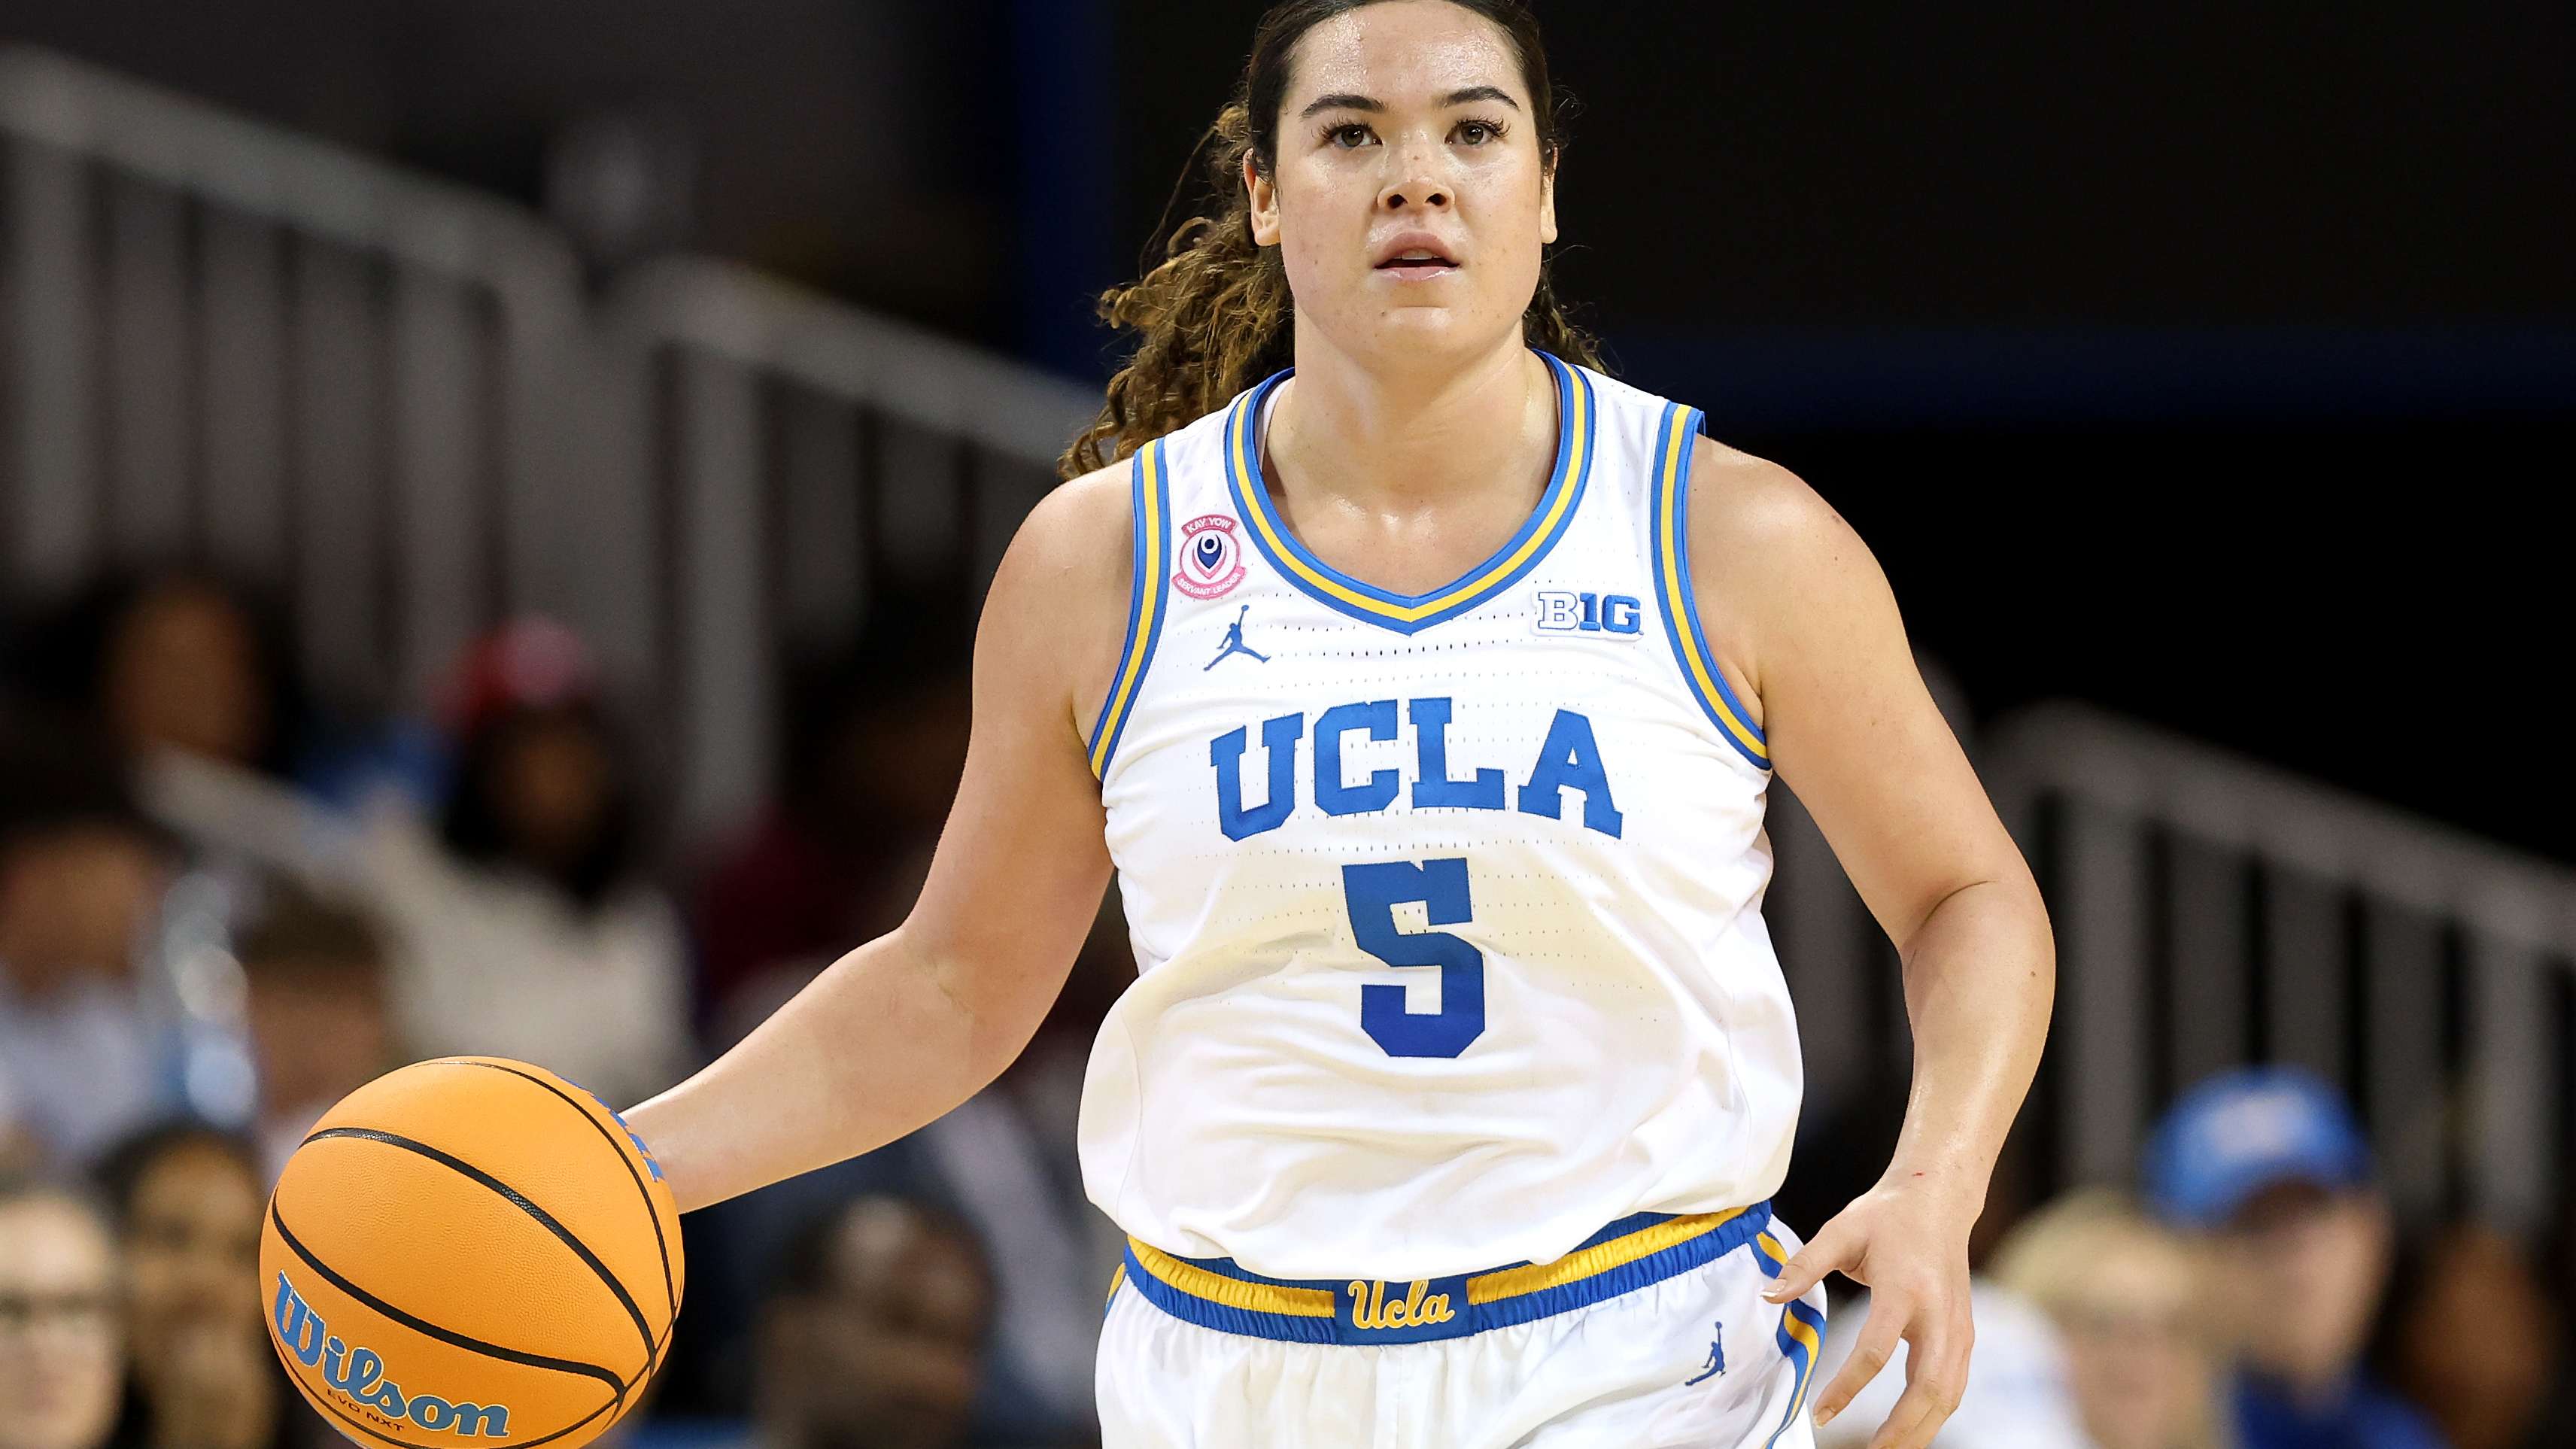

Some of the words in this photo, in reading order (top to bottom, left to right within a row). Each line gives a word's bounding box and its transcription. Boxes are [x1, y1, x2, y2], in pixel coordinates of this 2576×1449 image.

[1186, 518, 1205, 533] KAY
[1208, 517, 1232, 529] YOW
[1177, 578, 1211, 595] SERVANT
[1213, 572, 1241, 594] LEADER
[1211, 697, 1623, 842] UCLA
[1342, 858, 1485, 1058] 5
[1347, 1280, 1456, 1329] Ucla
[275, 1269, 509, 1437] Wilson
[327, 1388, 360, 1413] EVO
[366, 1411, 404, 1432] NXT
